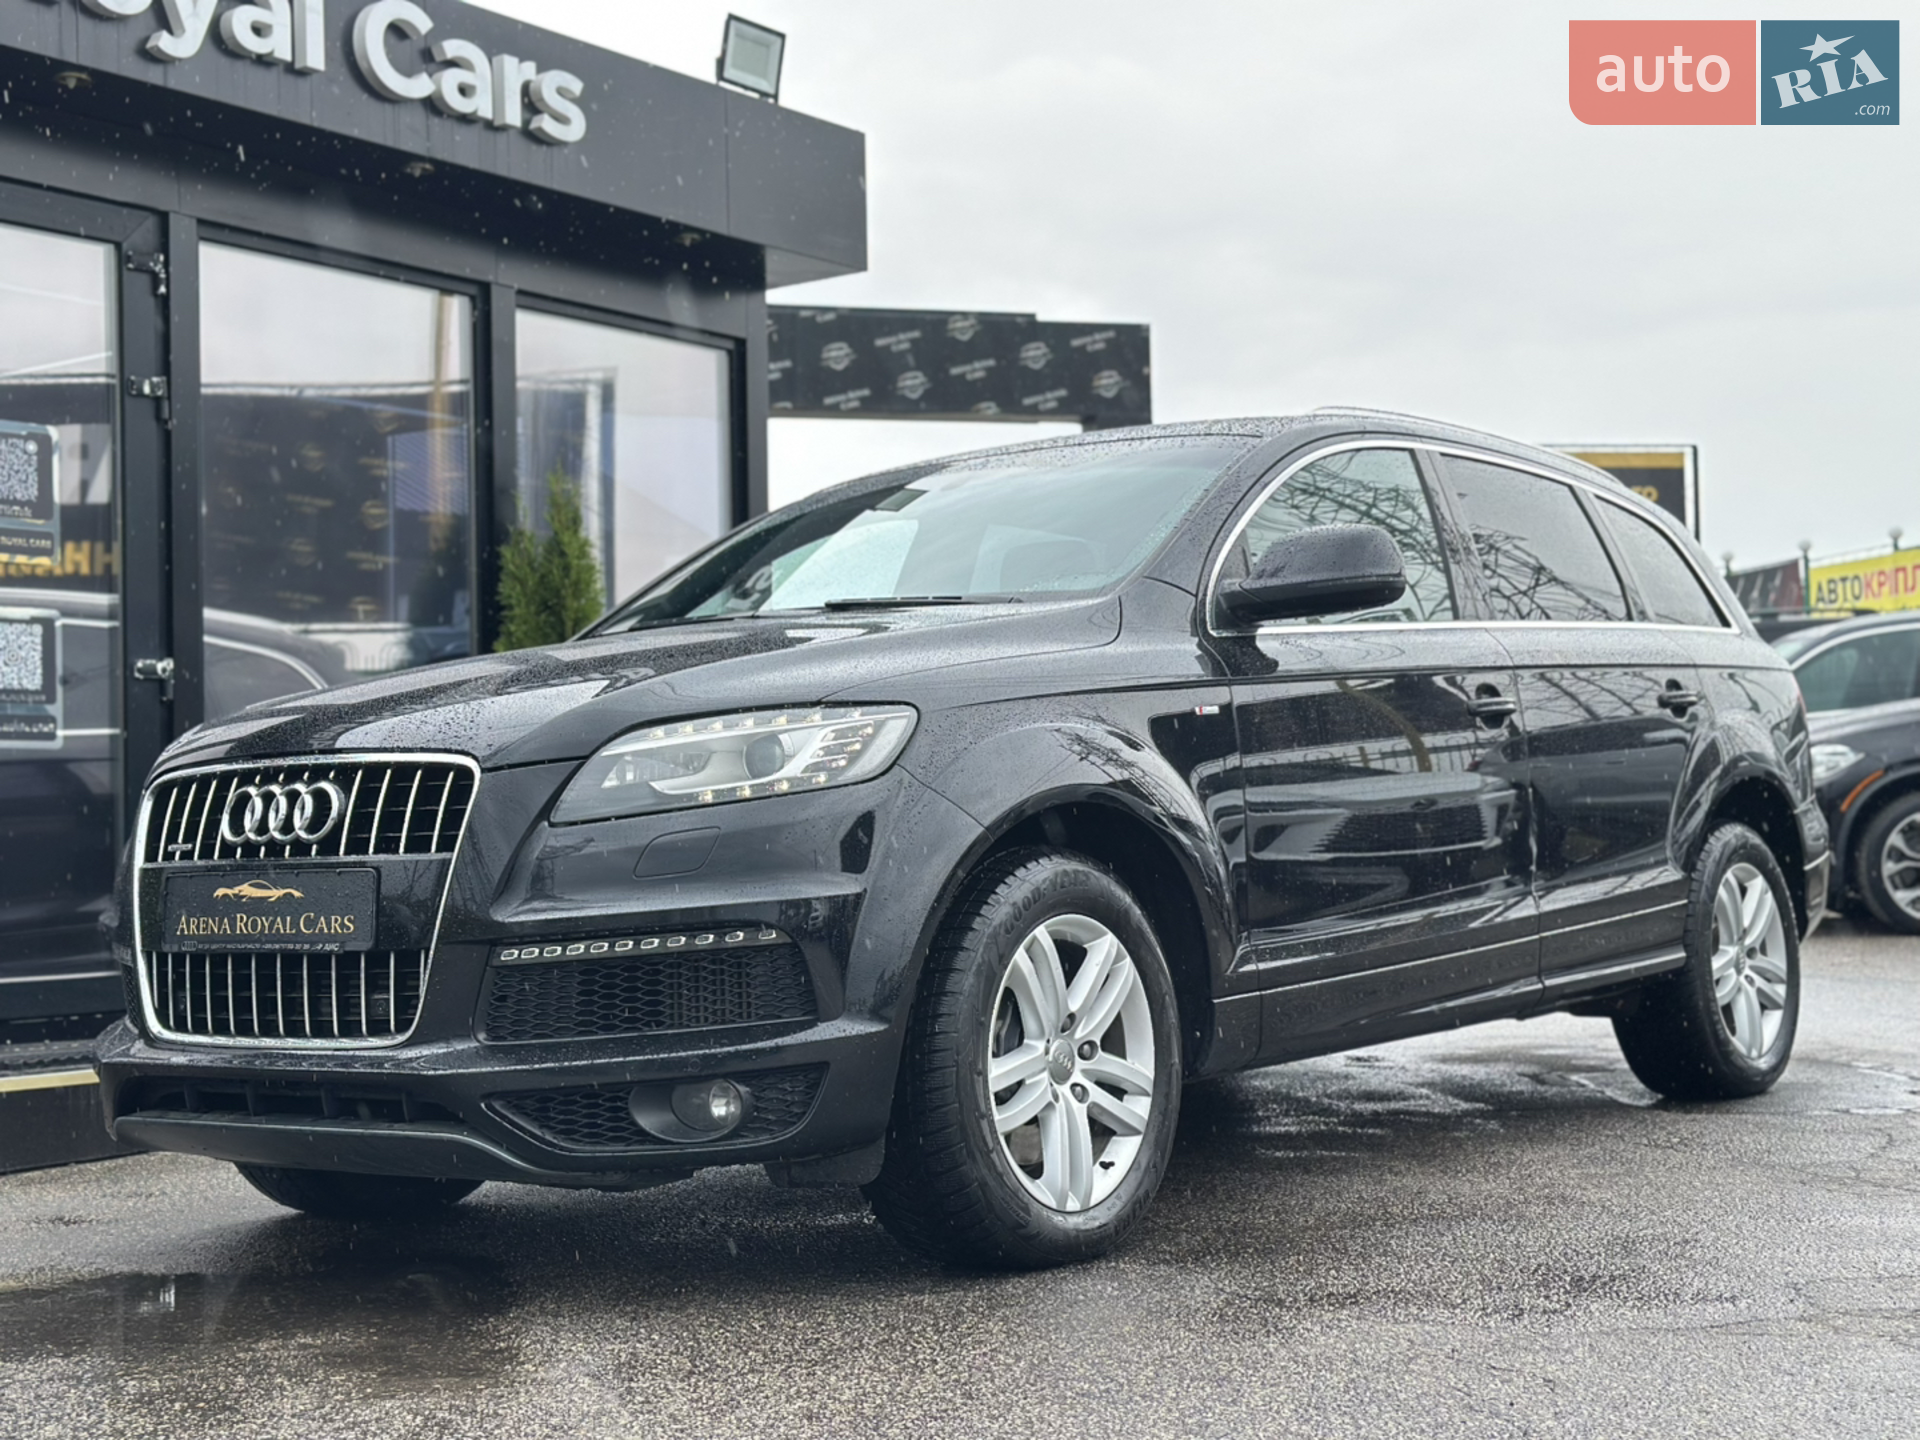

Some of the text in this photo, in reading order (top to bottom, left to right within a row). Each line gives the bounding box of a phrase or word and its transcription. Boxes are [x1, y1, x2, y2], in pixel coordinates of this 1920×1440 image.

[80, 0, 586, 143] yal Cars
[176, 912, 355, 935] ARENA ROYAL CARS
